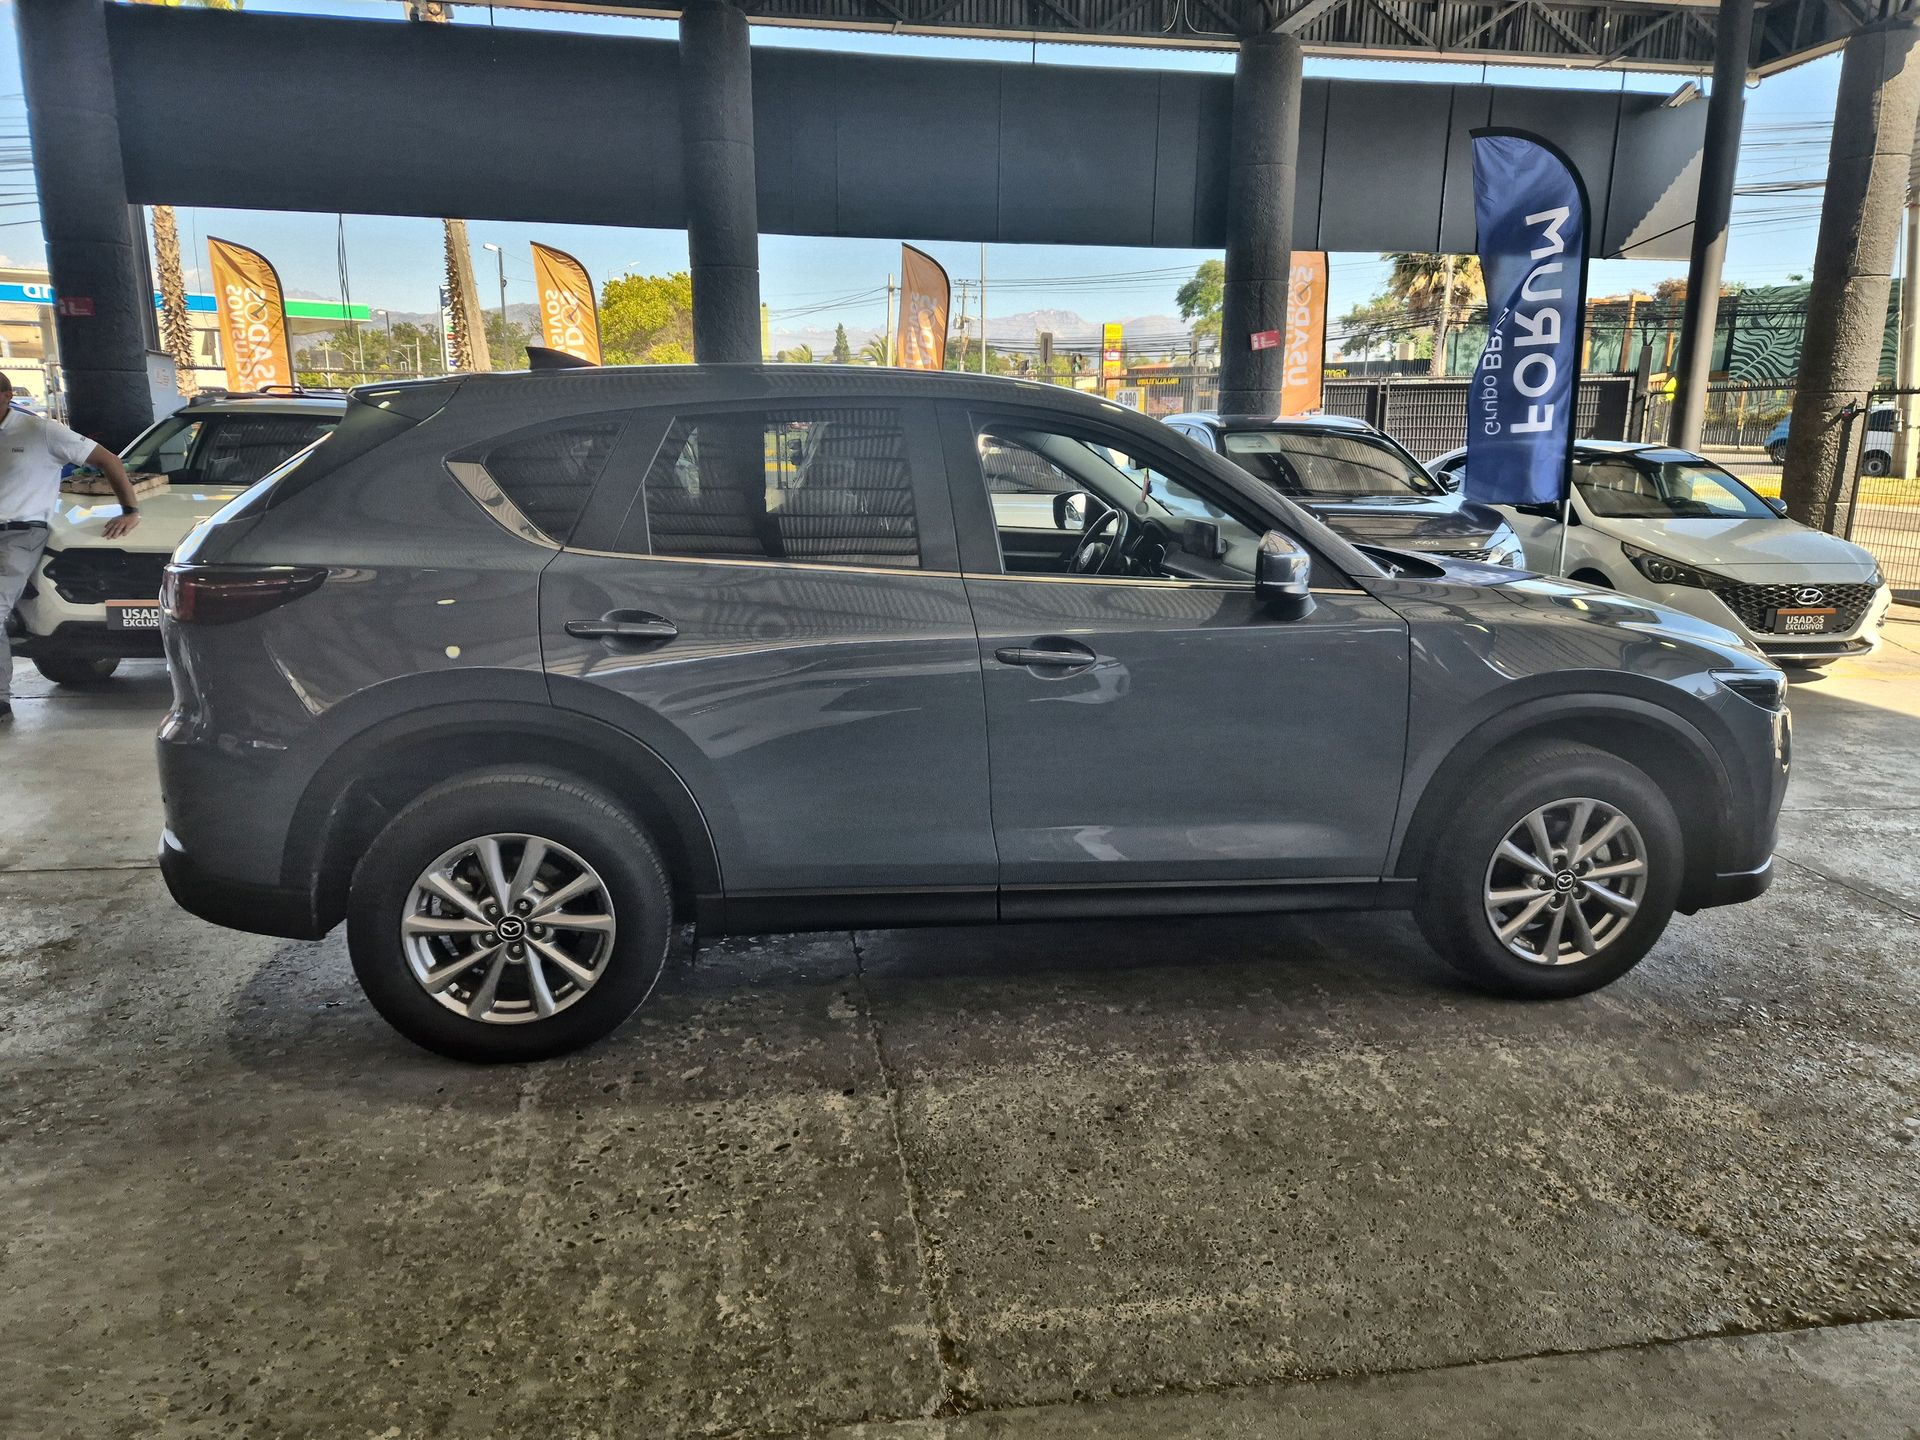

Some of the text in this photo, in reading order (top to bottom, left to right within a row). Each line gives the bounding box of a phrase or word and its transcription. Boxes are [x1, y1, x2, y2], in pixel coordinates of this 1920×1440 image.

[122, 608, 160, 619] USAD
[123, 619, 159, 627] EXCLUS
[1786, 615, 1824, 624] USADOS
